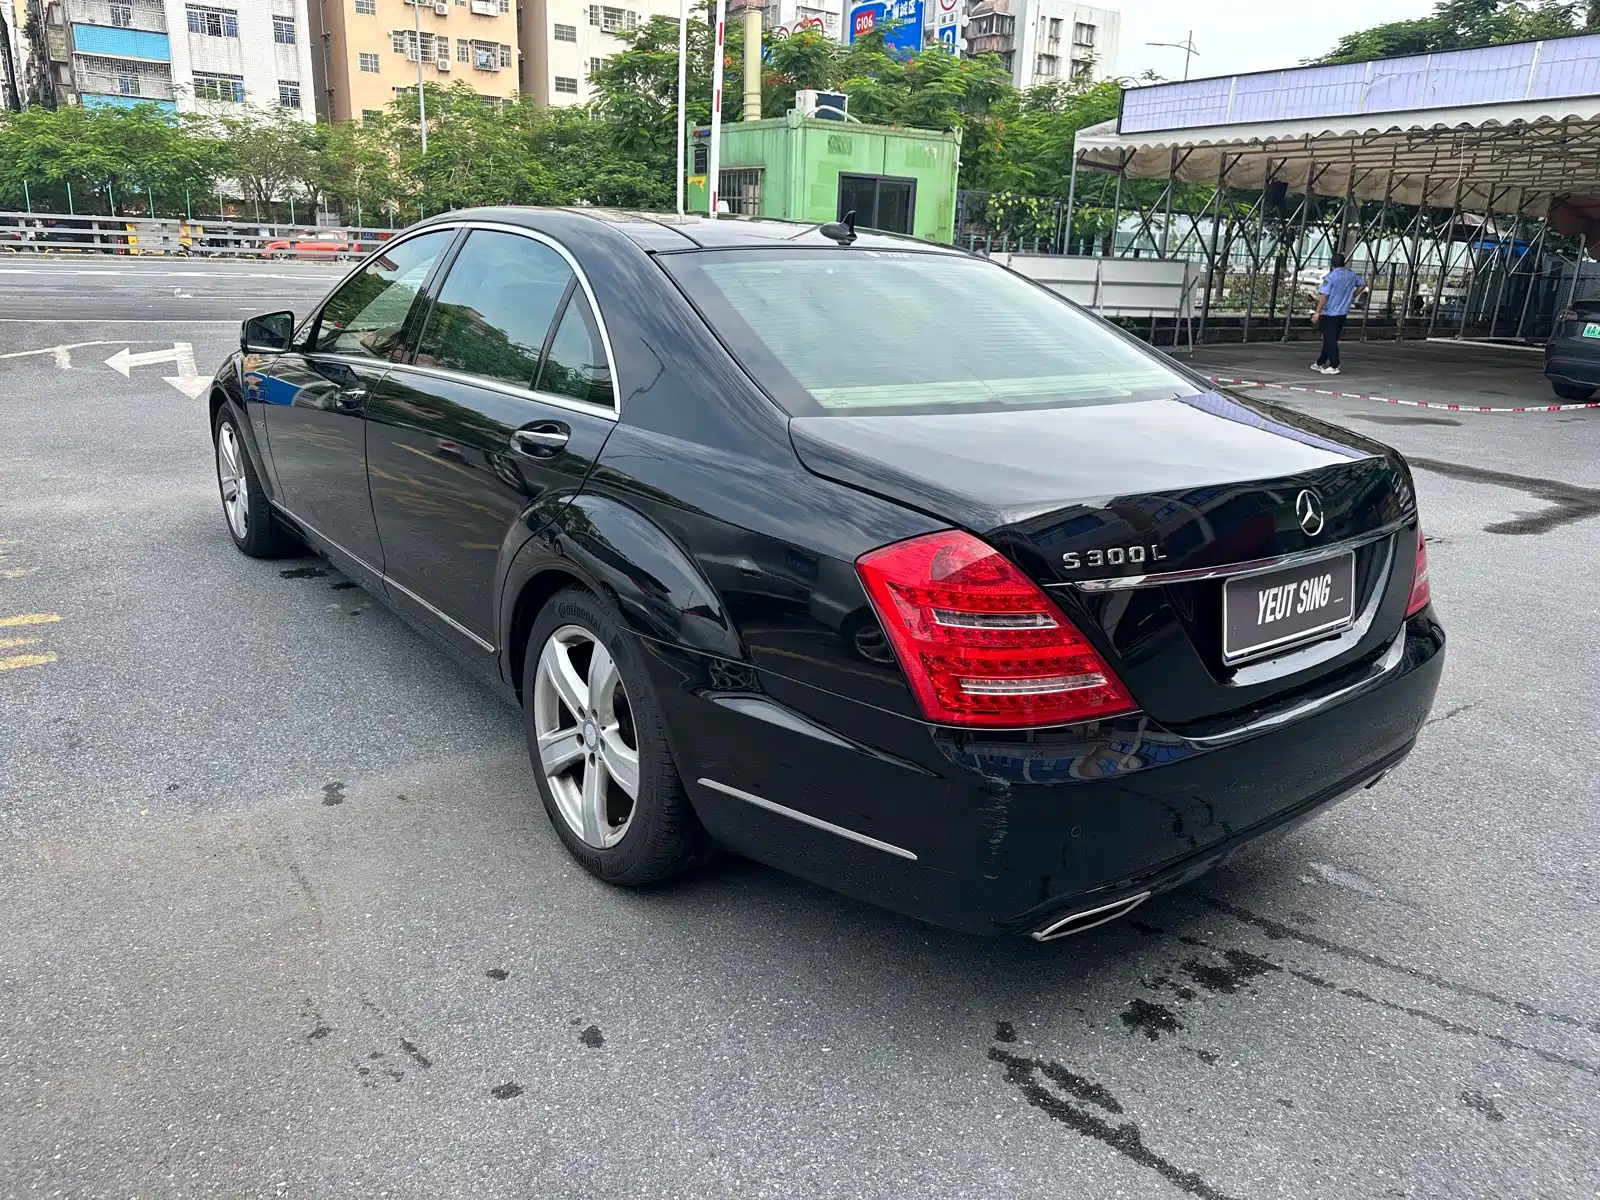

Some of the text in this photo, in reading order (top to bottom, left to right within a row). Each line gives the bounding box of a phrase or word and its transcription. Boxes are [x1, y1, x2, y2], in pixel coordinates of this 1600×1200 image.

[856, 14, 874, 31] G106
[1257, 573, 1332, 625] YEUT SING
[559, 601, 601, 633] Continental
